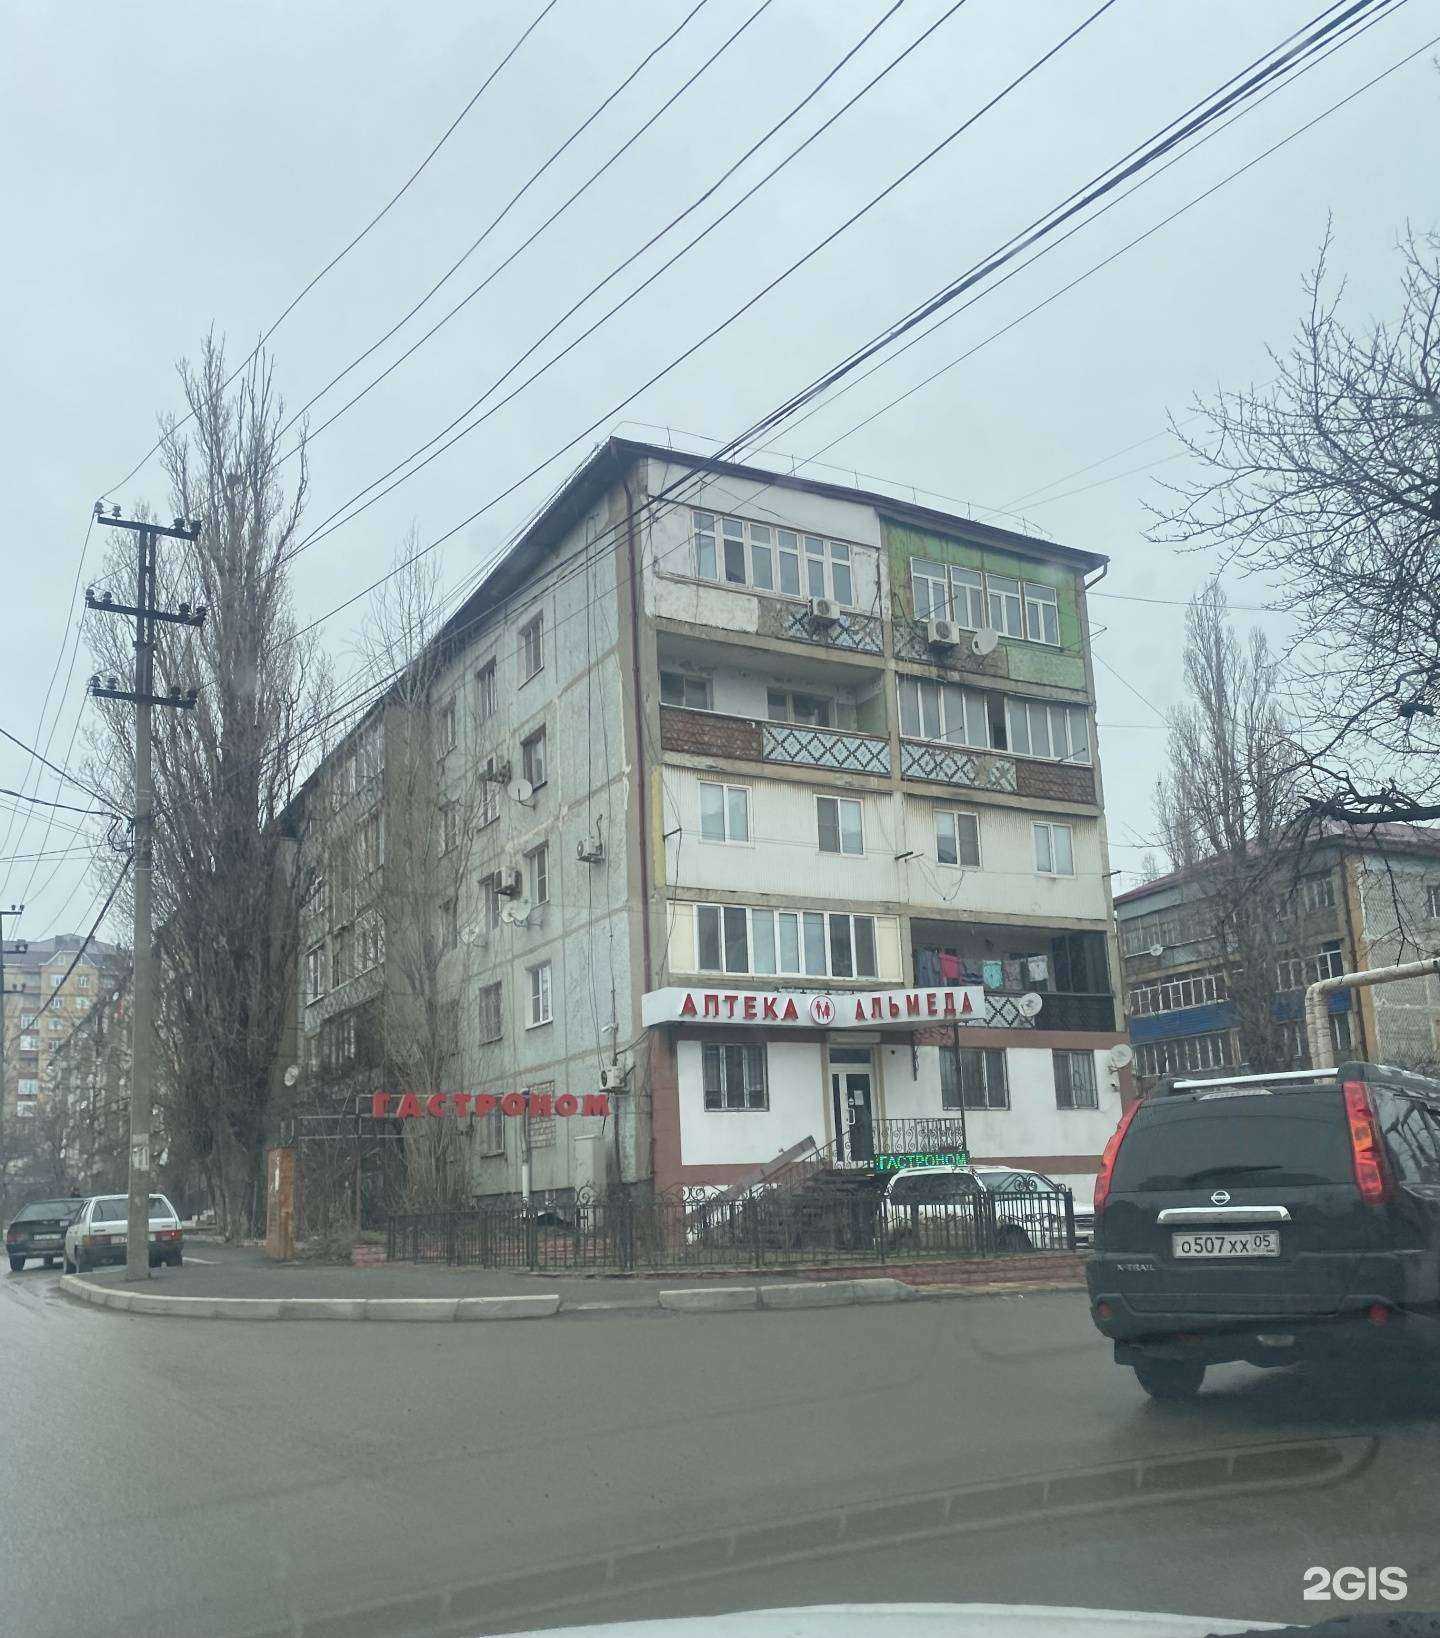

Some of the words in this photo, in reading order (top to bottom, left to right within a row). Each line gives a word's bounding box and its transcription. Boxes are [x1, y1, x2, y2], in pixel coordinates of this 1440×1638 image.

[679, 992, 799, 1021] АПТЕКА
[854, 990, 974, 1021] АЛЬМЕДА
[372, 1090, 610, 1118] ГАСТРОНОМ
[879, 1153, 967, 1170] ГАСТРОНОМ
